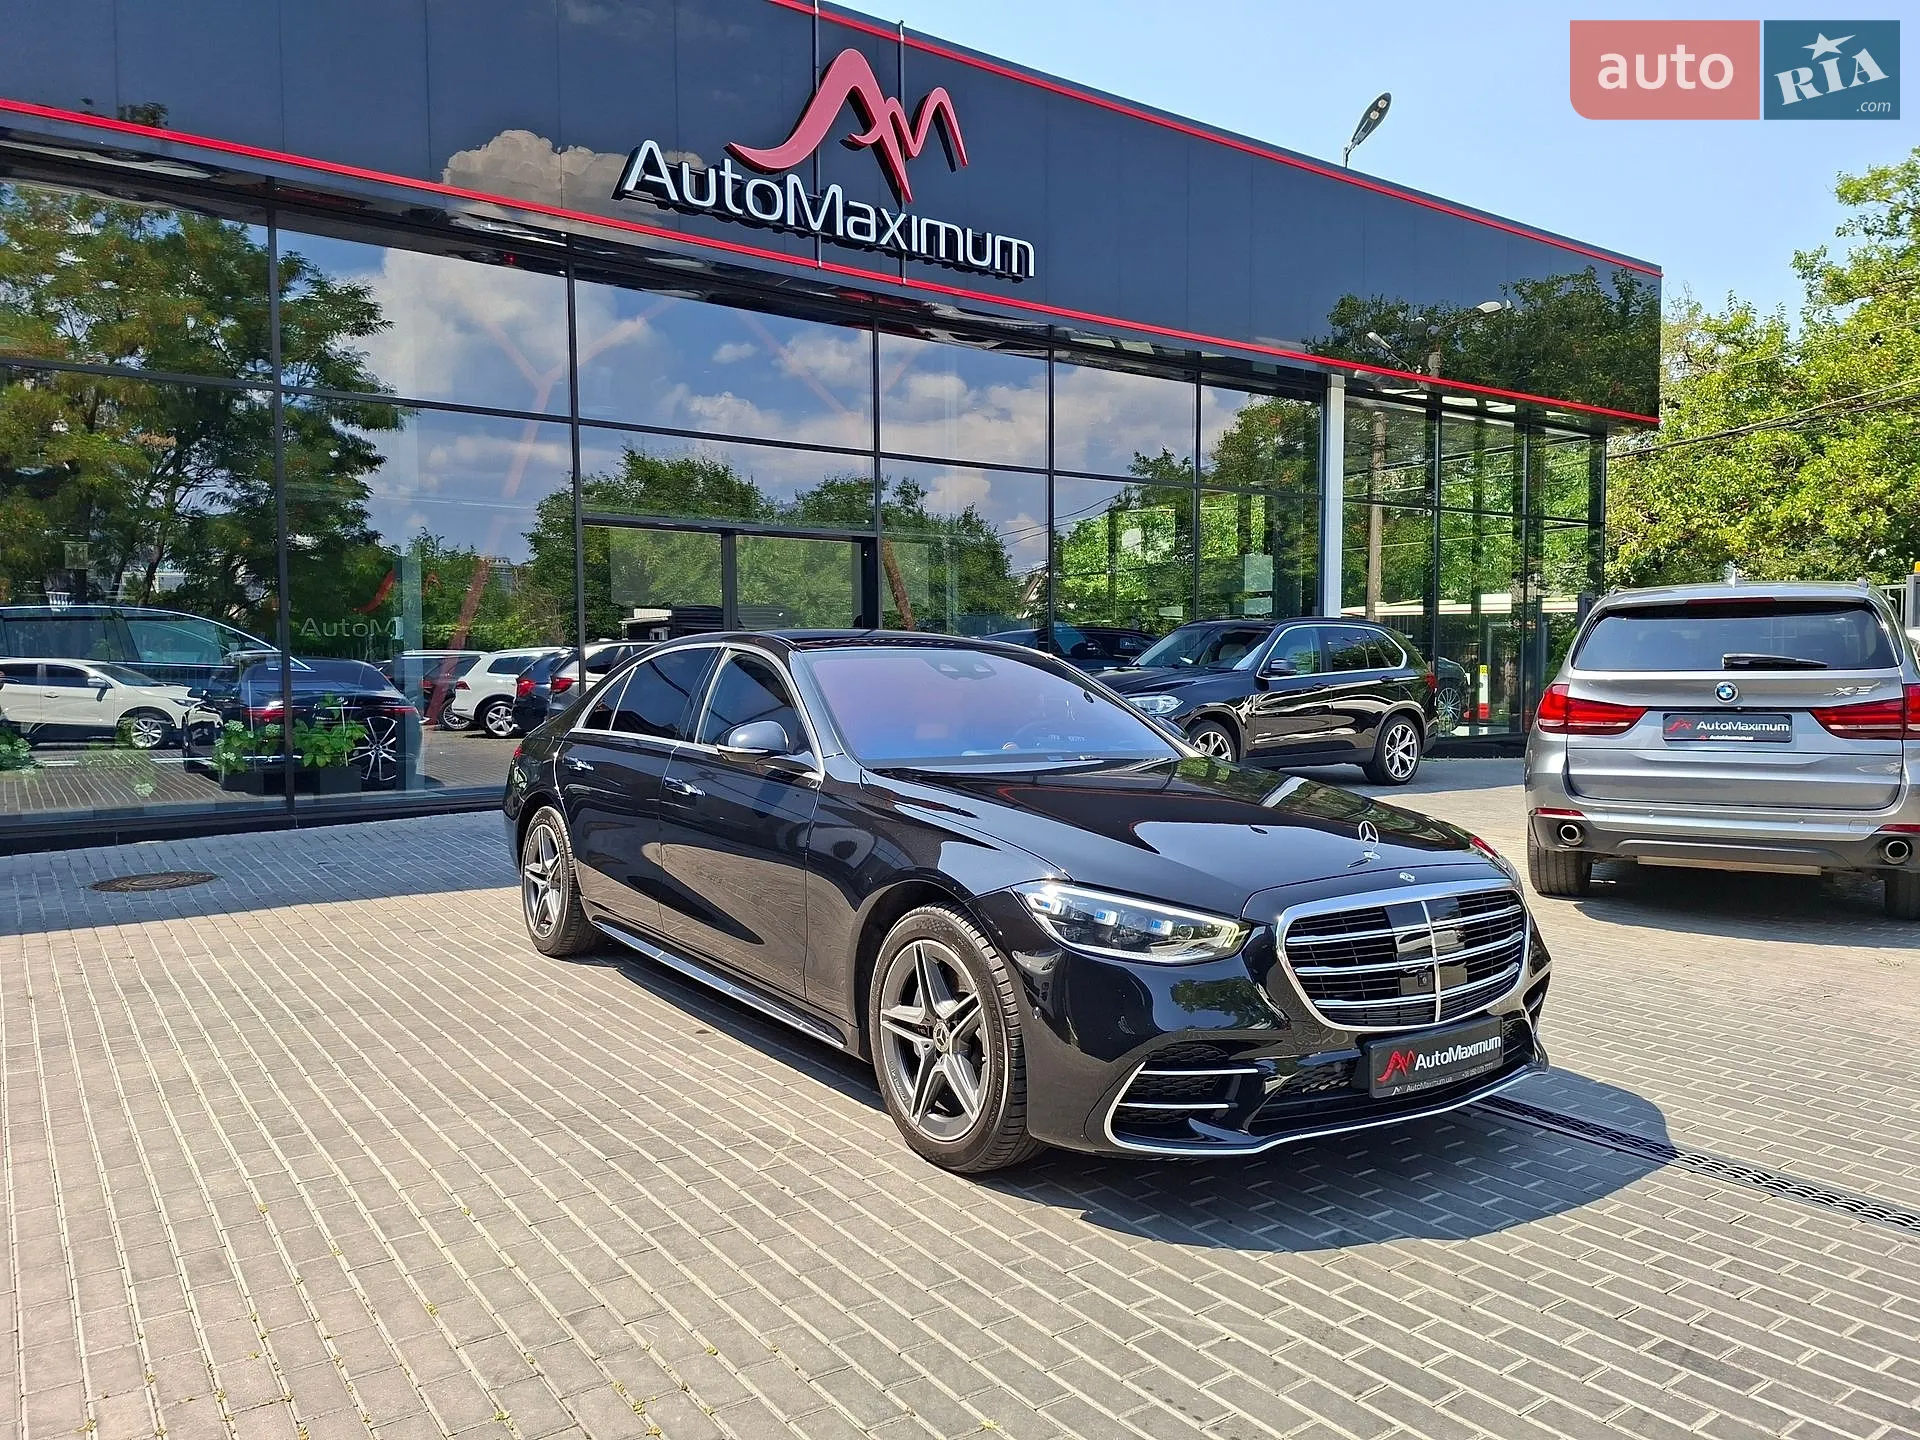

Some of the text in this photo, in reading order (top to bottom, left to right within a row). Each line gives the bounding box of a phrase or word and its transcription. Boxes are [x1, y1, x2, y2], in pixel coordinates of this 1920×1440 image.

[622, 138, 1035, 277] AutoMaximum
[1696, 720, 1790, 733] AutoMaximum
[1415, 1036, 1501, 1071] AutoMaximum
